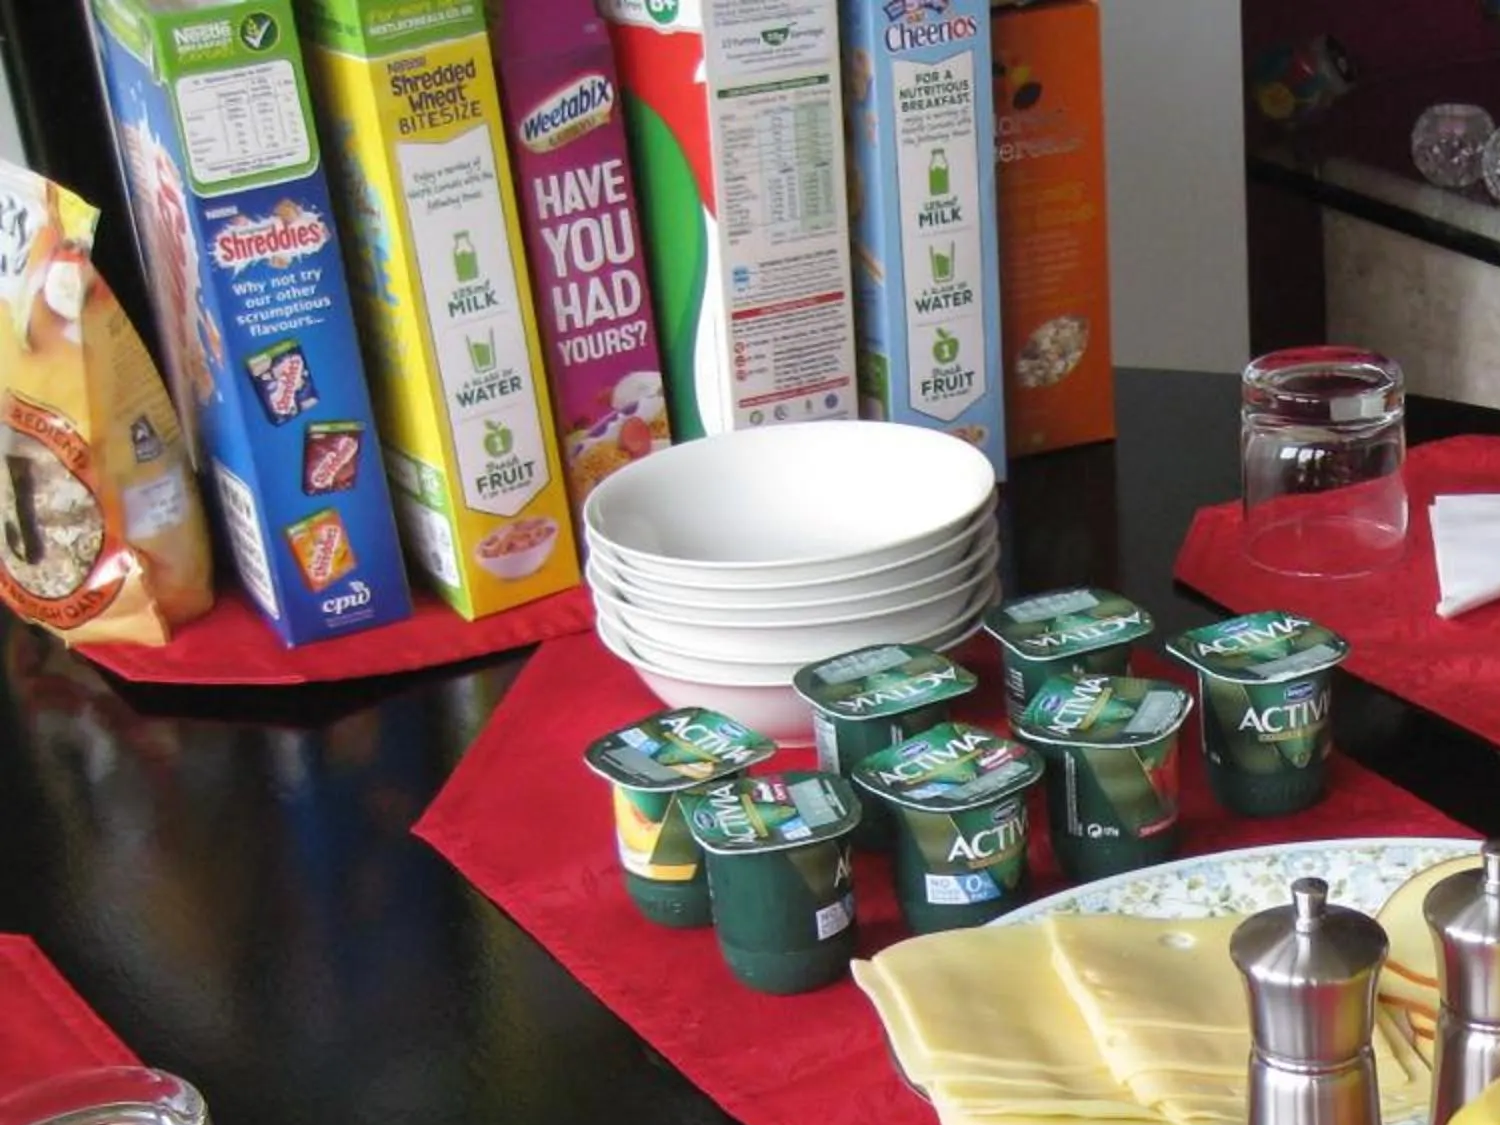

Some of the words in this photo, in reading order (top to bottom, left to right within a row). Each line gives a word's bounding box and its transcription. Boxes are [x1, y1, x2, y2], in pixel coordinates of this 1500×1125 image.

[885, 16, 977, 52] Cheerios
[391, 58, 476, 96] Shredded
[899, 80, 969, 100] NUTRITIOUS
[916, 72, 939, 84] FOR
[944, 70, 953, 80] A
[408, 83, 467, 113] Wheat
[524, 79, 611, 141] Weetabix
[901, 92, 970, 112] BREAKFAST
[399, 100, 482, 135] BITESIZE
[534, 159, 627, 220] HAVE
[918, 207, 962, 229] MILK
[220, 220, 322, 262] Shreddies
[541, 207, 635, 278] YOU
[232, 281, 266, 295] Why
[271, 274, 296, 287] not
[300, 267, 322, 282] try
[245, 295, 271, 309] our
[276, 285, 316, 302] other
[236, 296, 332, 325] scrumptious
[448, 291, 499, 318] MILK
[552, 269, 641, 333] HAD
[915, 289, 974, 314] WATER
[557, 320, 648, 367] YOURS?
[456, 375, 522, 408] WATER
[921, 370, 975, 396] FRUIT
[475, 461, 536, 494] FRUIT
[1022, 611, 1141, 648] ACTIVIA
[1198, 616, 1311, 657] ACTIVIA
[835, 665, 957, 713] ACTIVIA
[1048, 676, 1110, 737] ACTIVIA
[658, 716, 755, 764] ACTIVIA
[879, 732, 993, 787] ACTIVIA
[706, 783, 759, 844] ACTIVIA
[947, 807, 1028, 863] ACTIV
